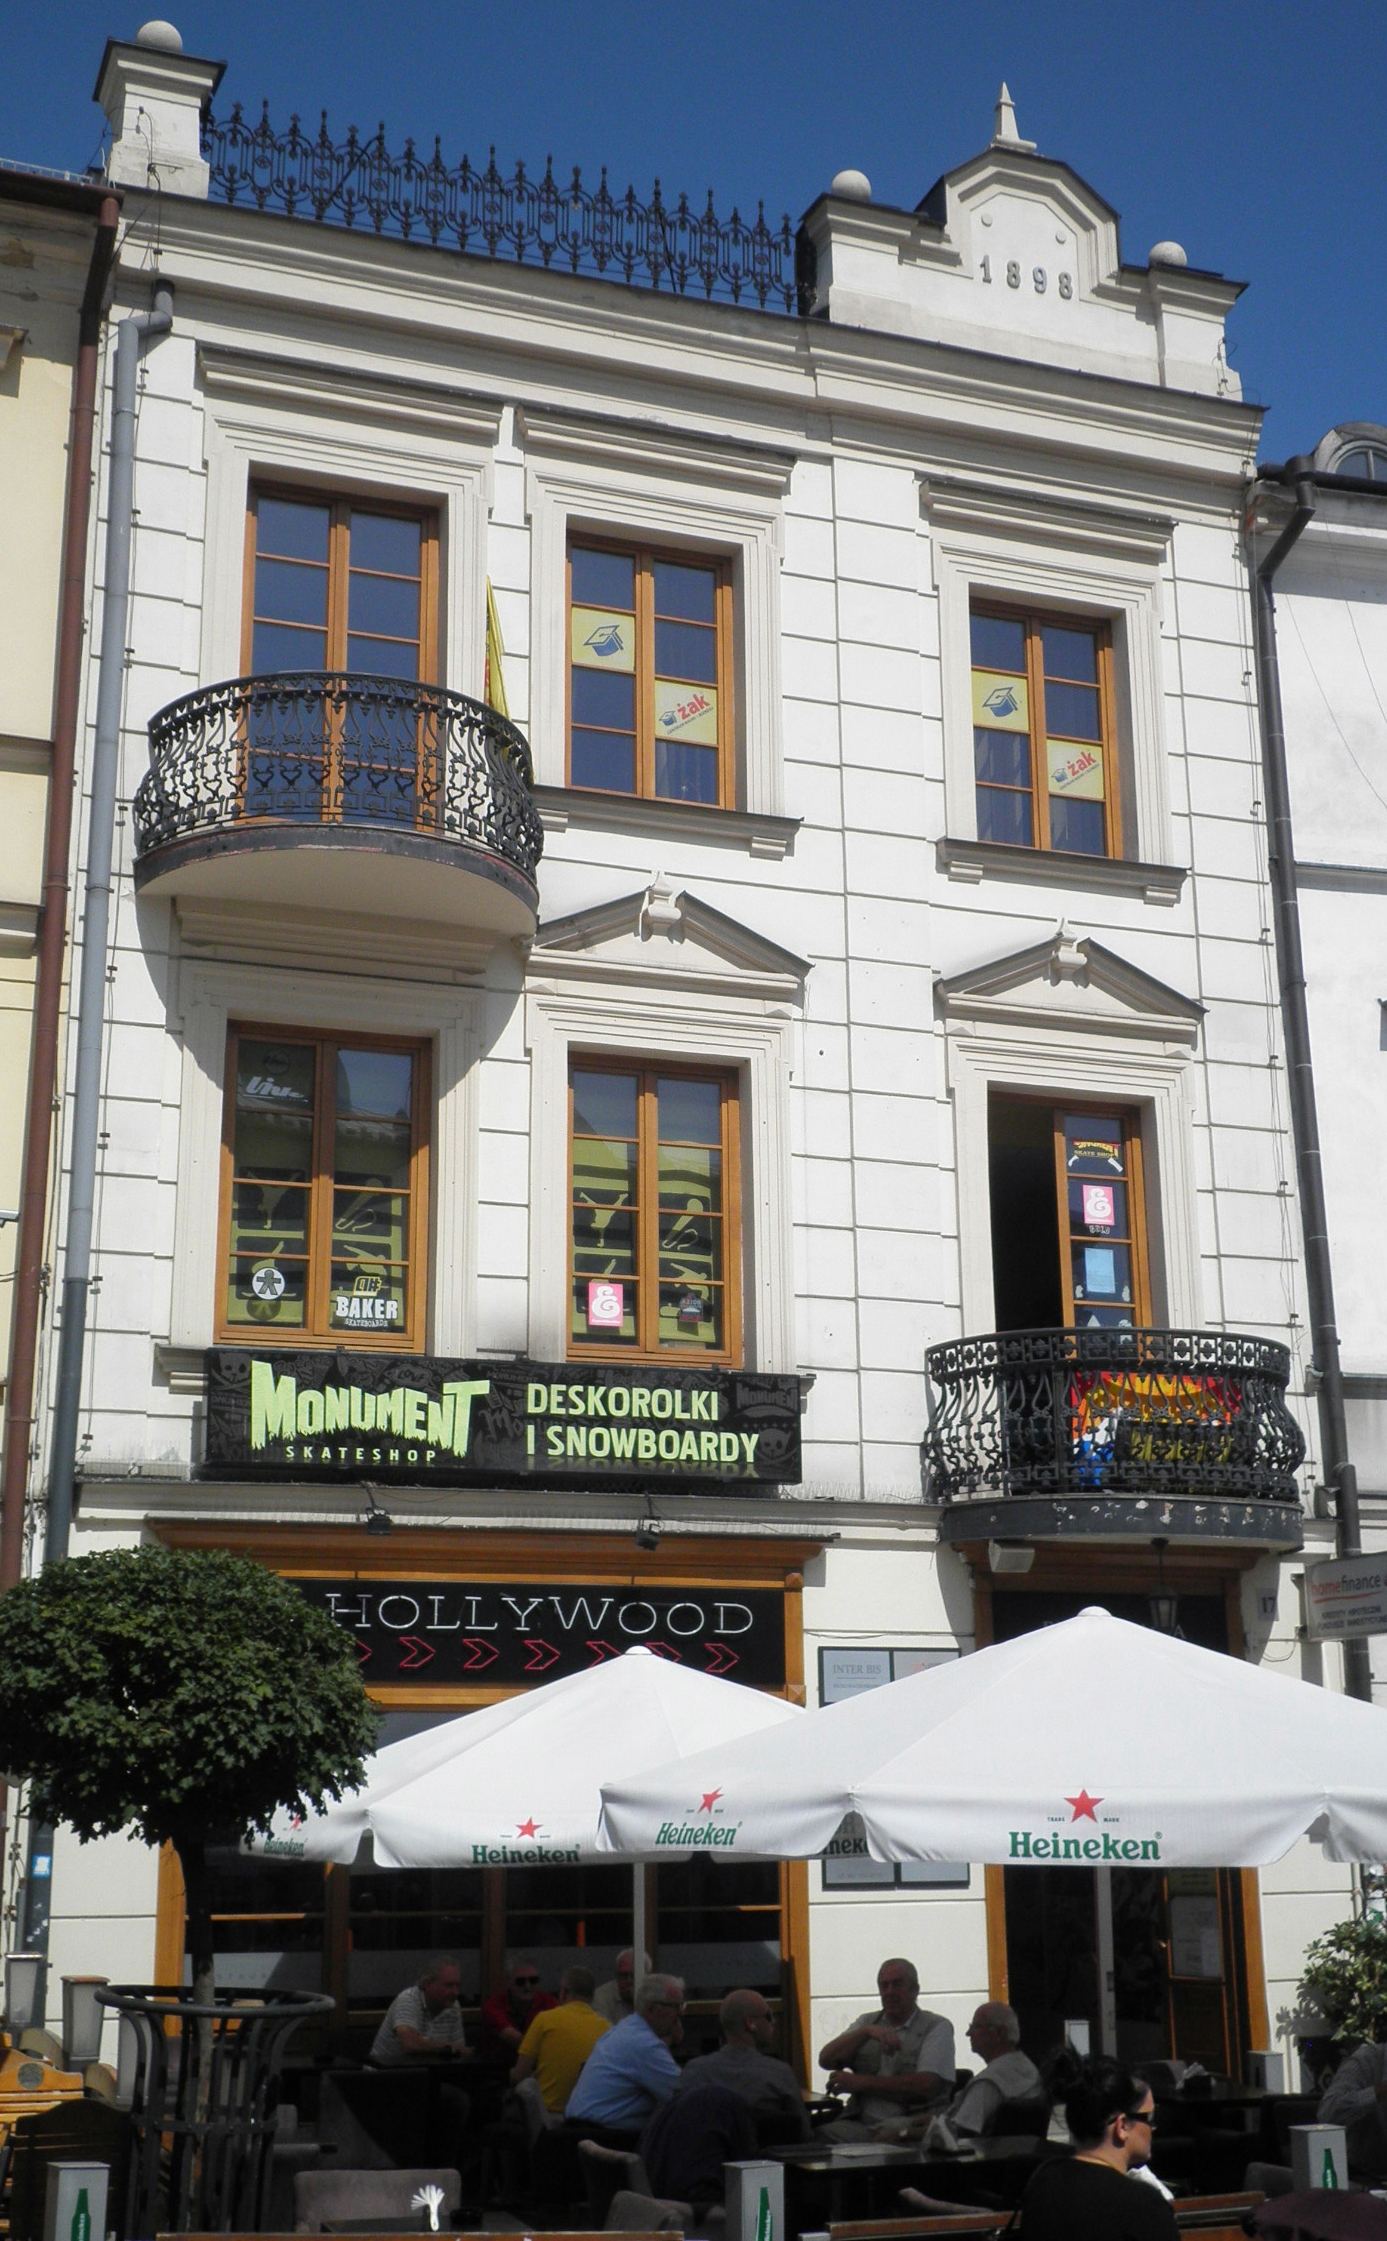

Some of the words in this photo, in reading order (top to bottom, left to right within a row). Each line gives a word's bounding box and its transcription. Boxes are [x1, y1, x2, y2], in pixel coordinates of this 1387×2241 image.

[980, 255, 1073, 300] 1898
[677, 693, 711, 720] żak
[1067, 751, 1097, 777] żak
[336, 1296, 398, 1319] BAKER
[344, 1318, 389, 1328] SKATEBOARDS
[251, 1360, 490, 1457] MONUMENT
[527, 1383, 719, 1421] DESKOROLKI
[286, 1446, 436, 1461] SKATESHOP
[527, 1425, 535, 1455] I
[547, 1425, 759, 1463] SNOWBOARDY
[325, 1593, 753, 1636] HOLLYWOOD
[1262, 1596, 1276, 1613] 17
[833, 1664, 864, 1675] INTER
[867, 1664, 882, 1675] BIS
[655, 1822, 738, 1846] Heineken
[1009, 1831, 1161, 1860] Heineken
[472, 1844, 580, 1864] Heineken
